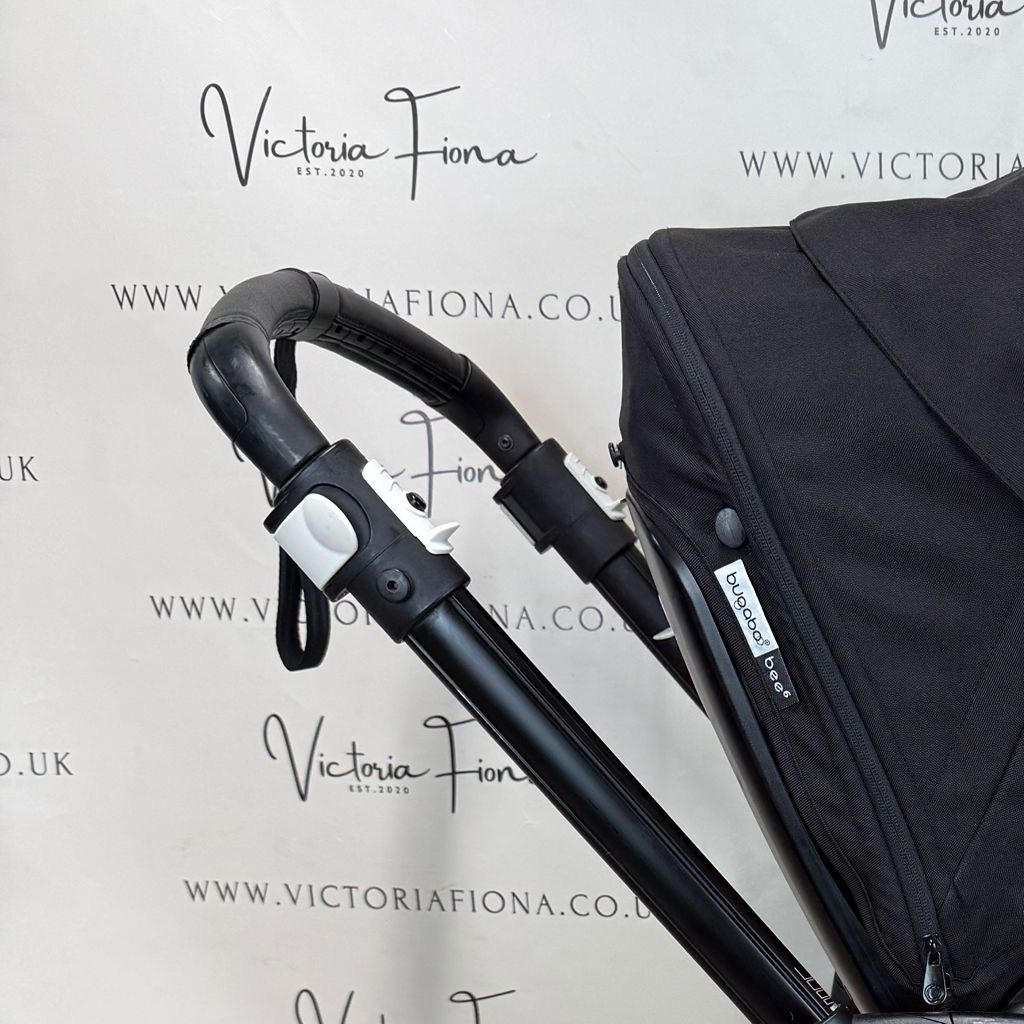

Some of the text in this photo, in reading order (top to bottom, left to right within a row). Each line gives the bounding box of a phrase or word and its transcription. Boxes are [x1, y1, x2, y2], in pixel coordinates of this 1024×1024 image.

[934, 27, 999, 36] EST.2020
[200, 83, 538, 201] Victoria Fiona
[297, 167, 364, 178] EST.2020
[400, 410, 503, 518] Fion
[263, 714, 534, 814] Victoria Fion
[349, 785, 409, 794] EST.2020
[184, 880, 651, 919] WWW.VICTORIAFIONA.CO.U
